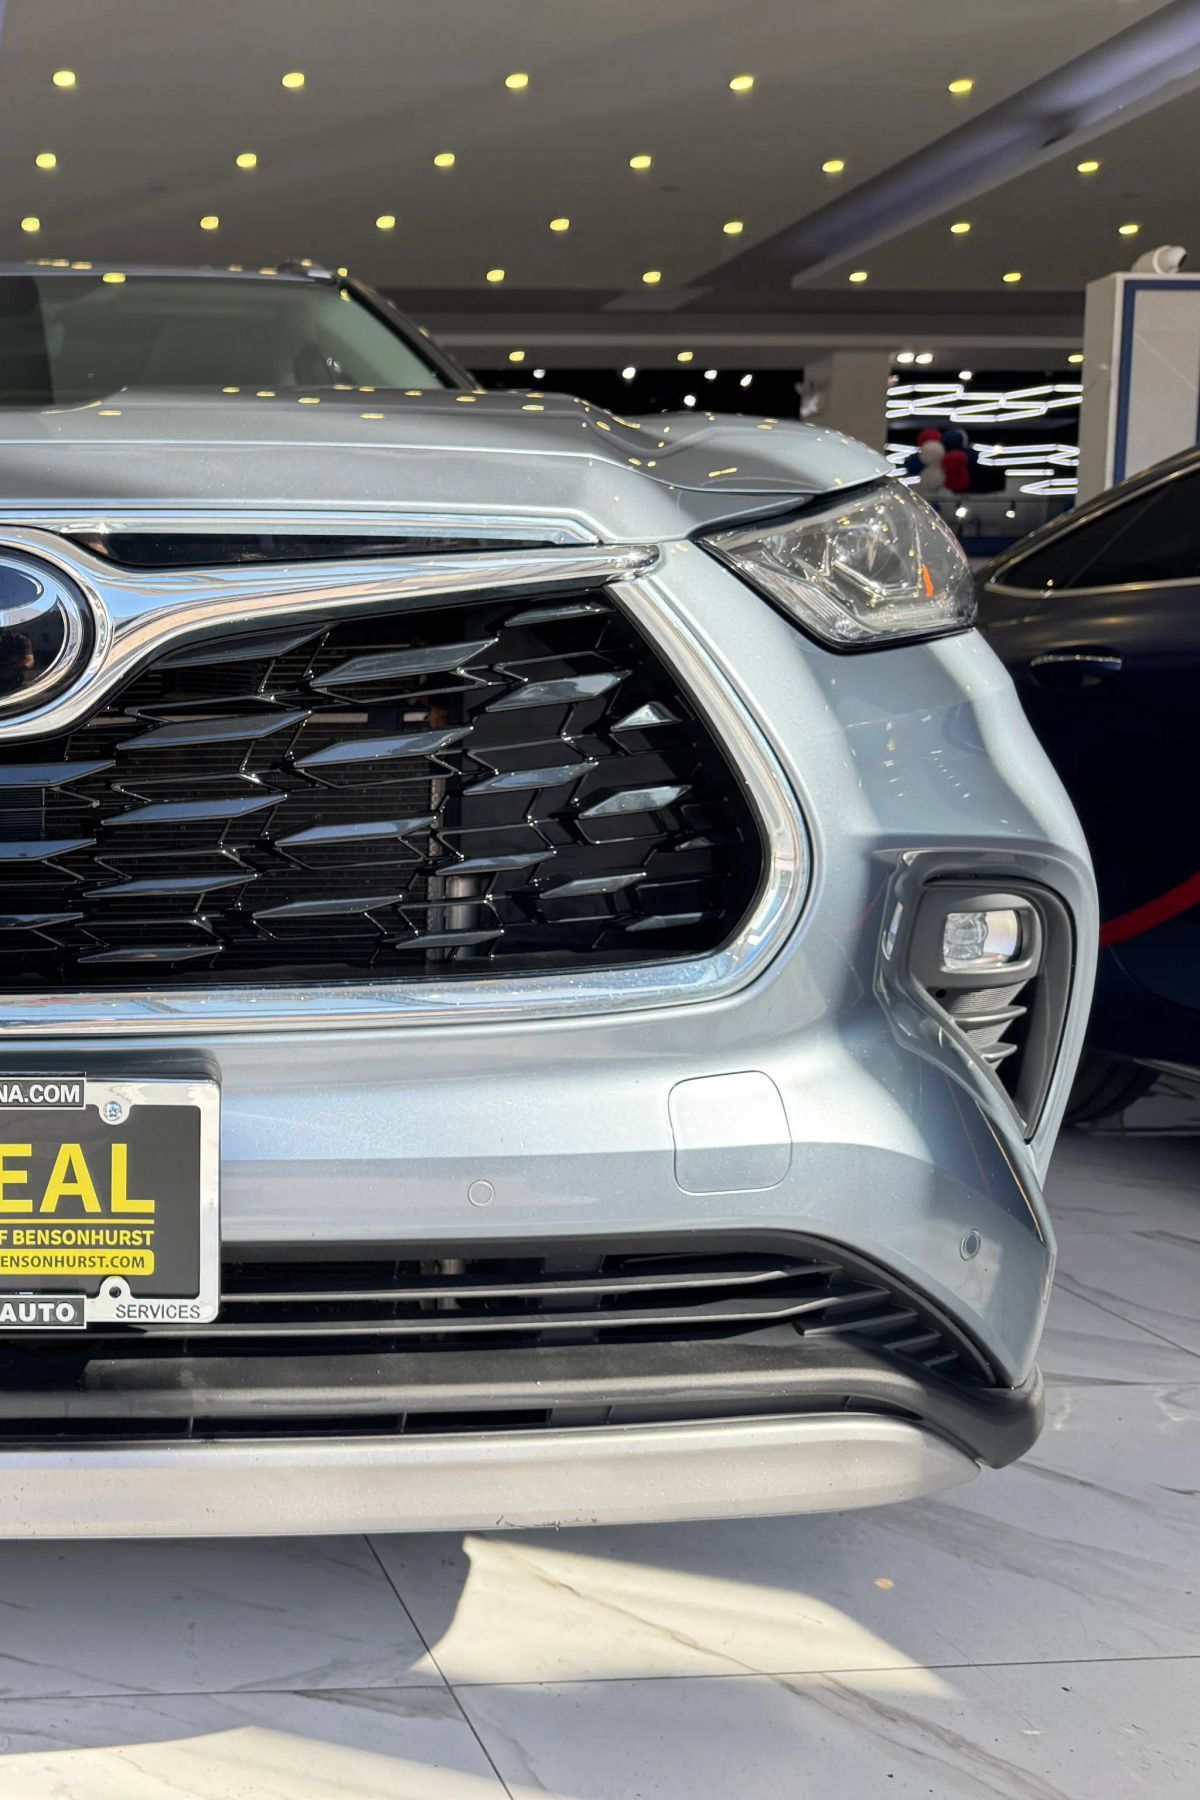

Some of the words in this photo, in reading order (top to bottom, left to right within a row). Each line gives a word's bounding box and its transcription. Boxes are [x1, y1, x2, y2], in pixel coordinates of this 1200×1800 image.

[12, 1229, 155, 1246] BENSONHURST
[0, 1303, 76, 1322] AUTO
[115, 1304, 200, 1319] SERVICES
